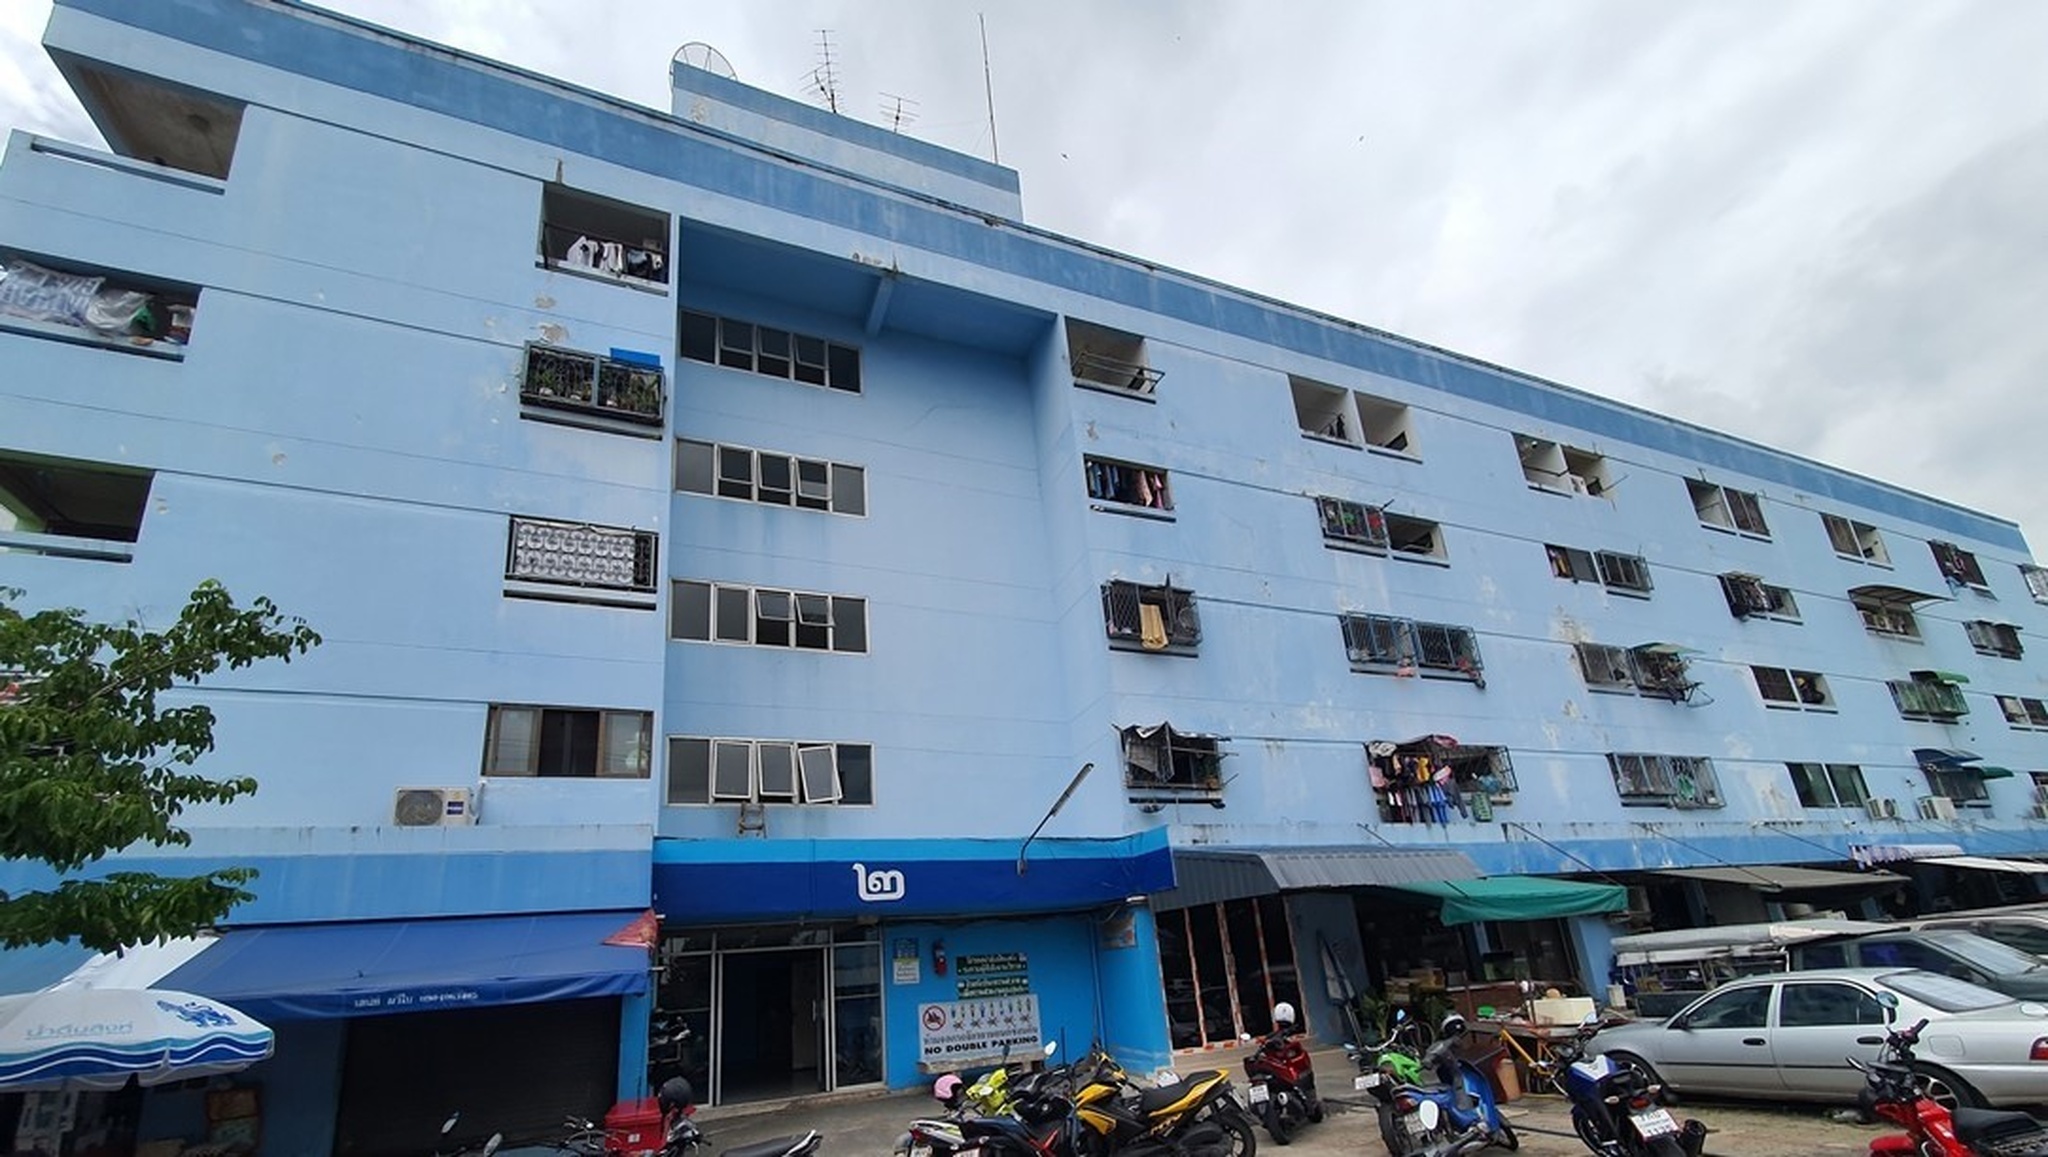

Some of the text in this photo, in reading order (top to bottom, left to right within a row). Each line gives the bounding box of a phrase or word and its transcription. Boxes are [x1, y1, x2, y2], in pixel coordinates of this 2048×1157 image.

[924, 1035, 1039, 1056] NO DOUBLE PARKING
